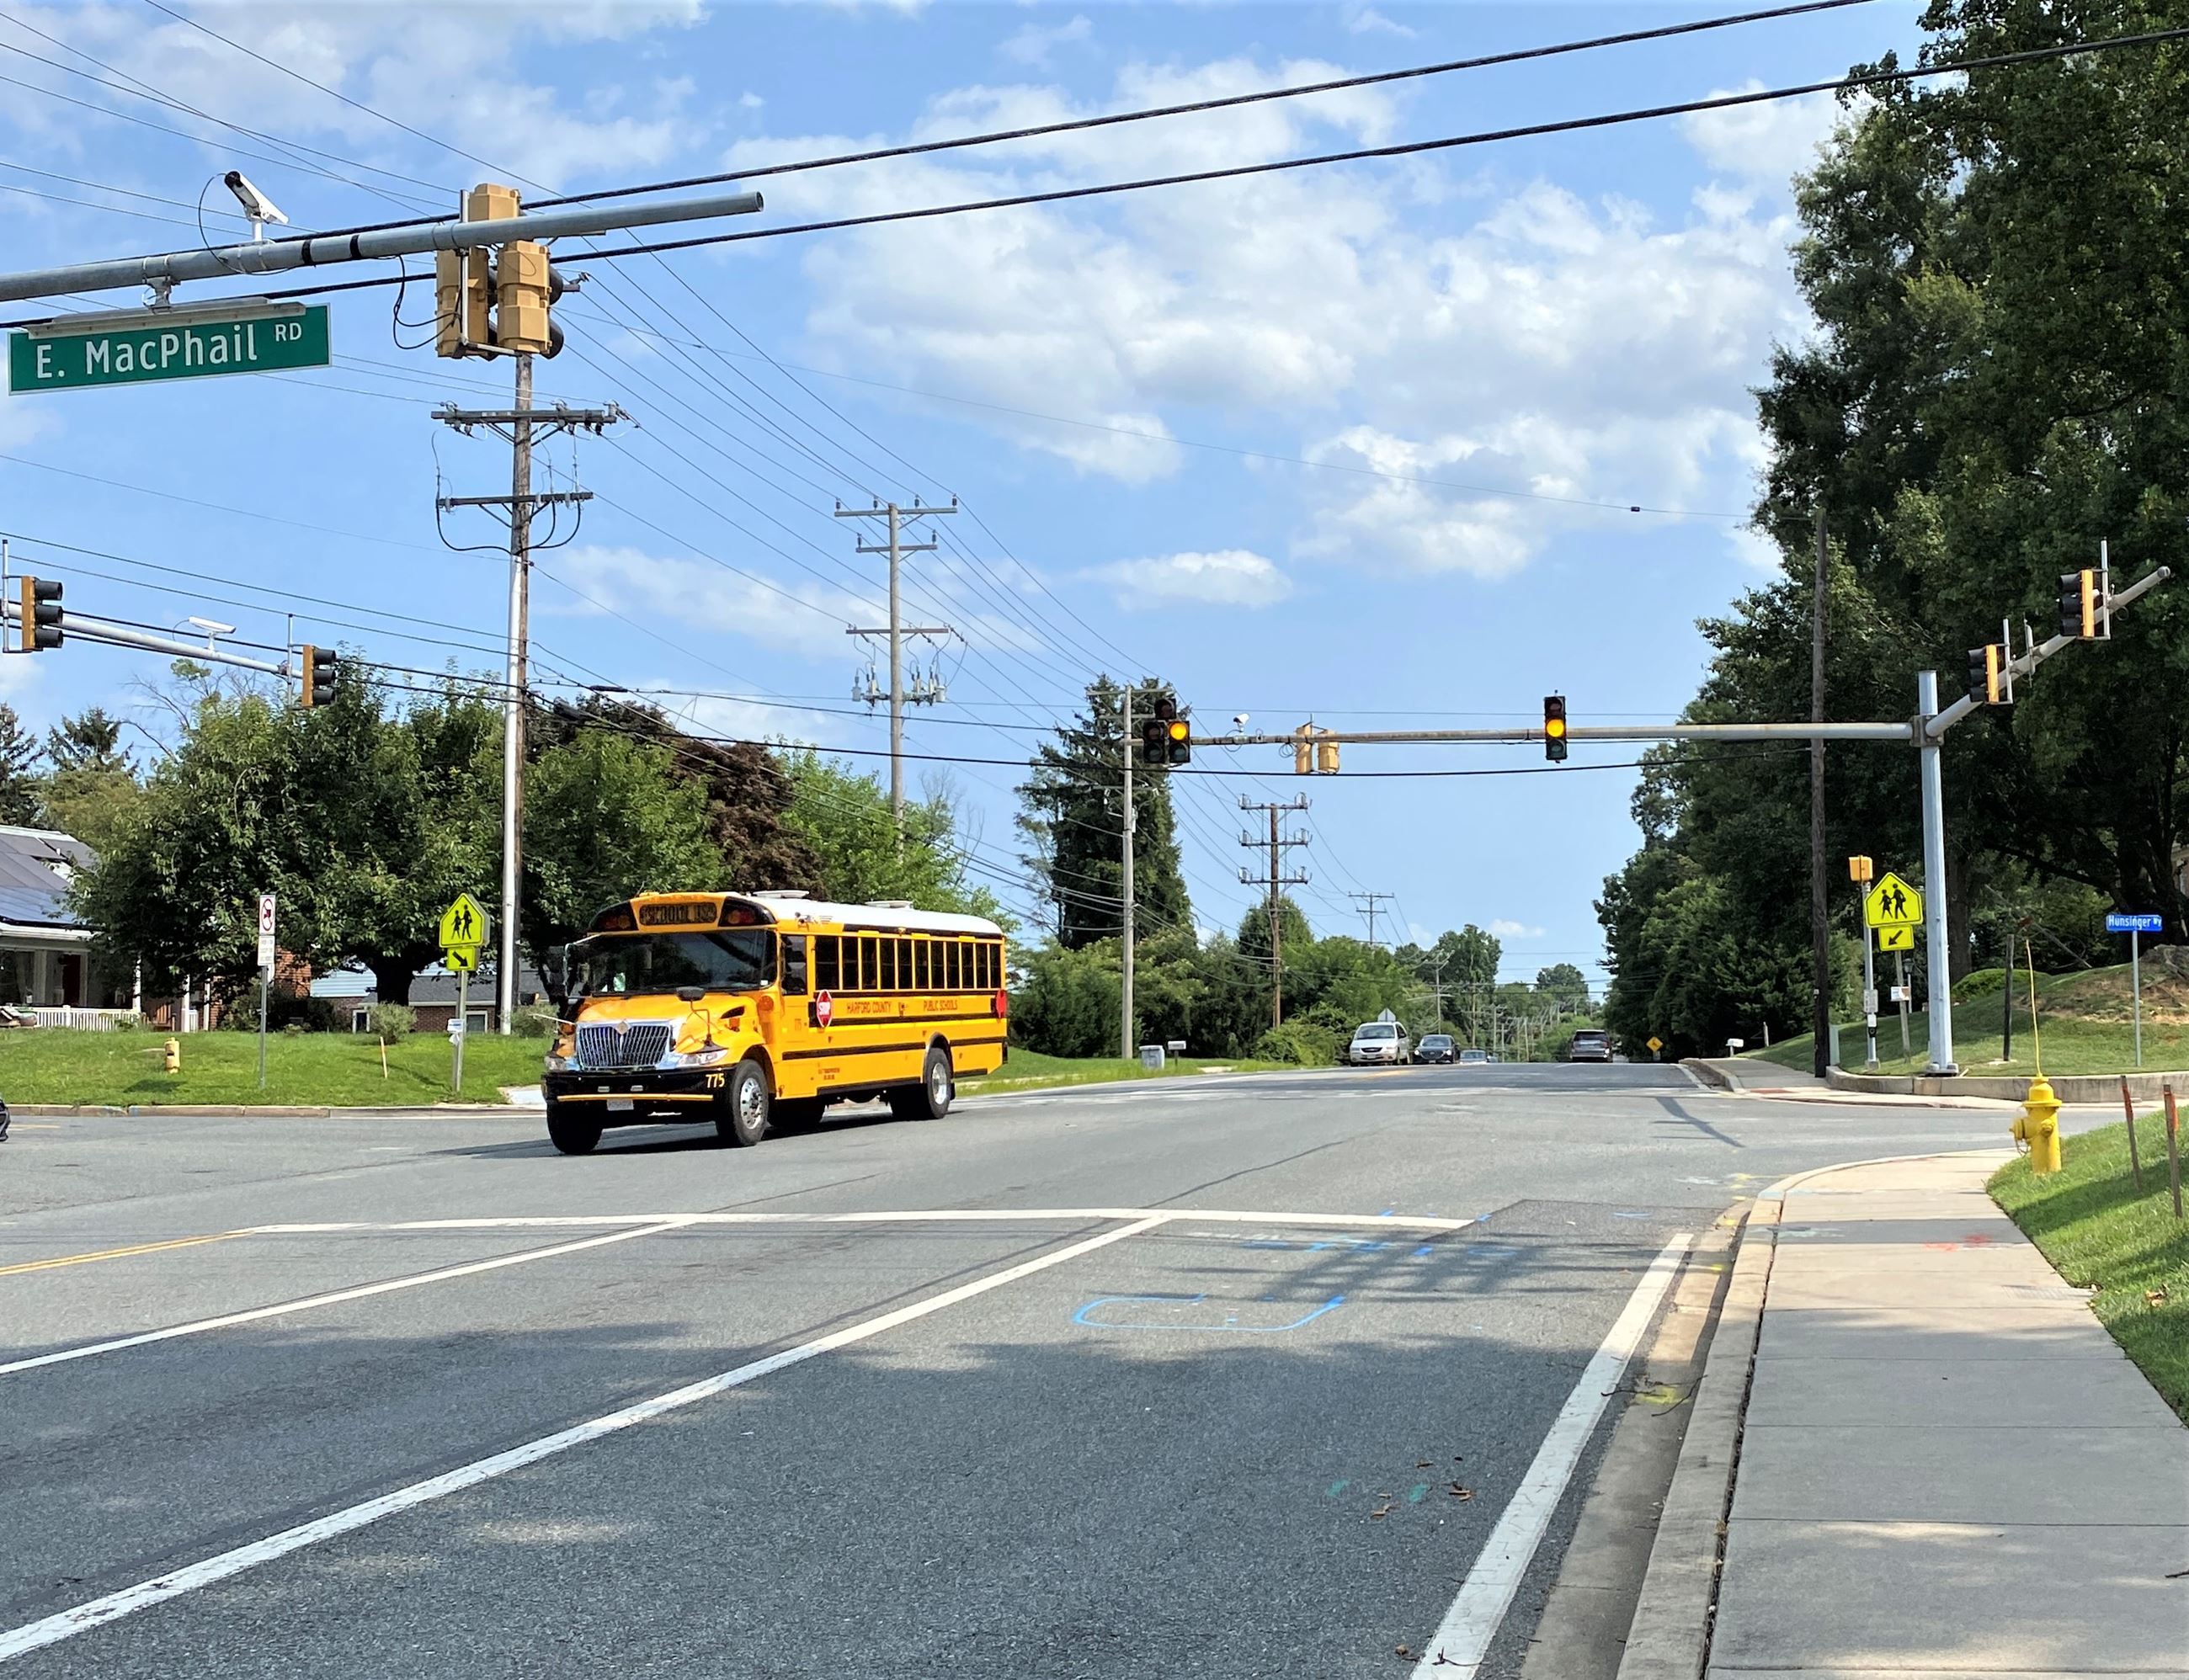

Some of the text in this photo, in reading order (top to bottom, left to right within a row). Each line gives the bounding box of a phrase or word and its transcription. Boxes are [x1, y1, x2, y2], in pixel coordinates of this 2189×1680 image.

[36, 322, 302, 379] E. MacPhail RD
[2108, 915, 2151, 930] Hunsinger
[847, 999, 957, 1014] HARFORD COUNTY PUBLIC SCHOOLS
[706, 1073, 725, 1088] 775
